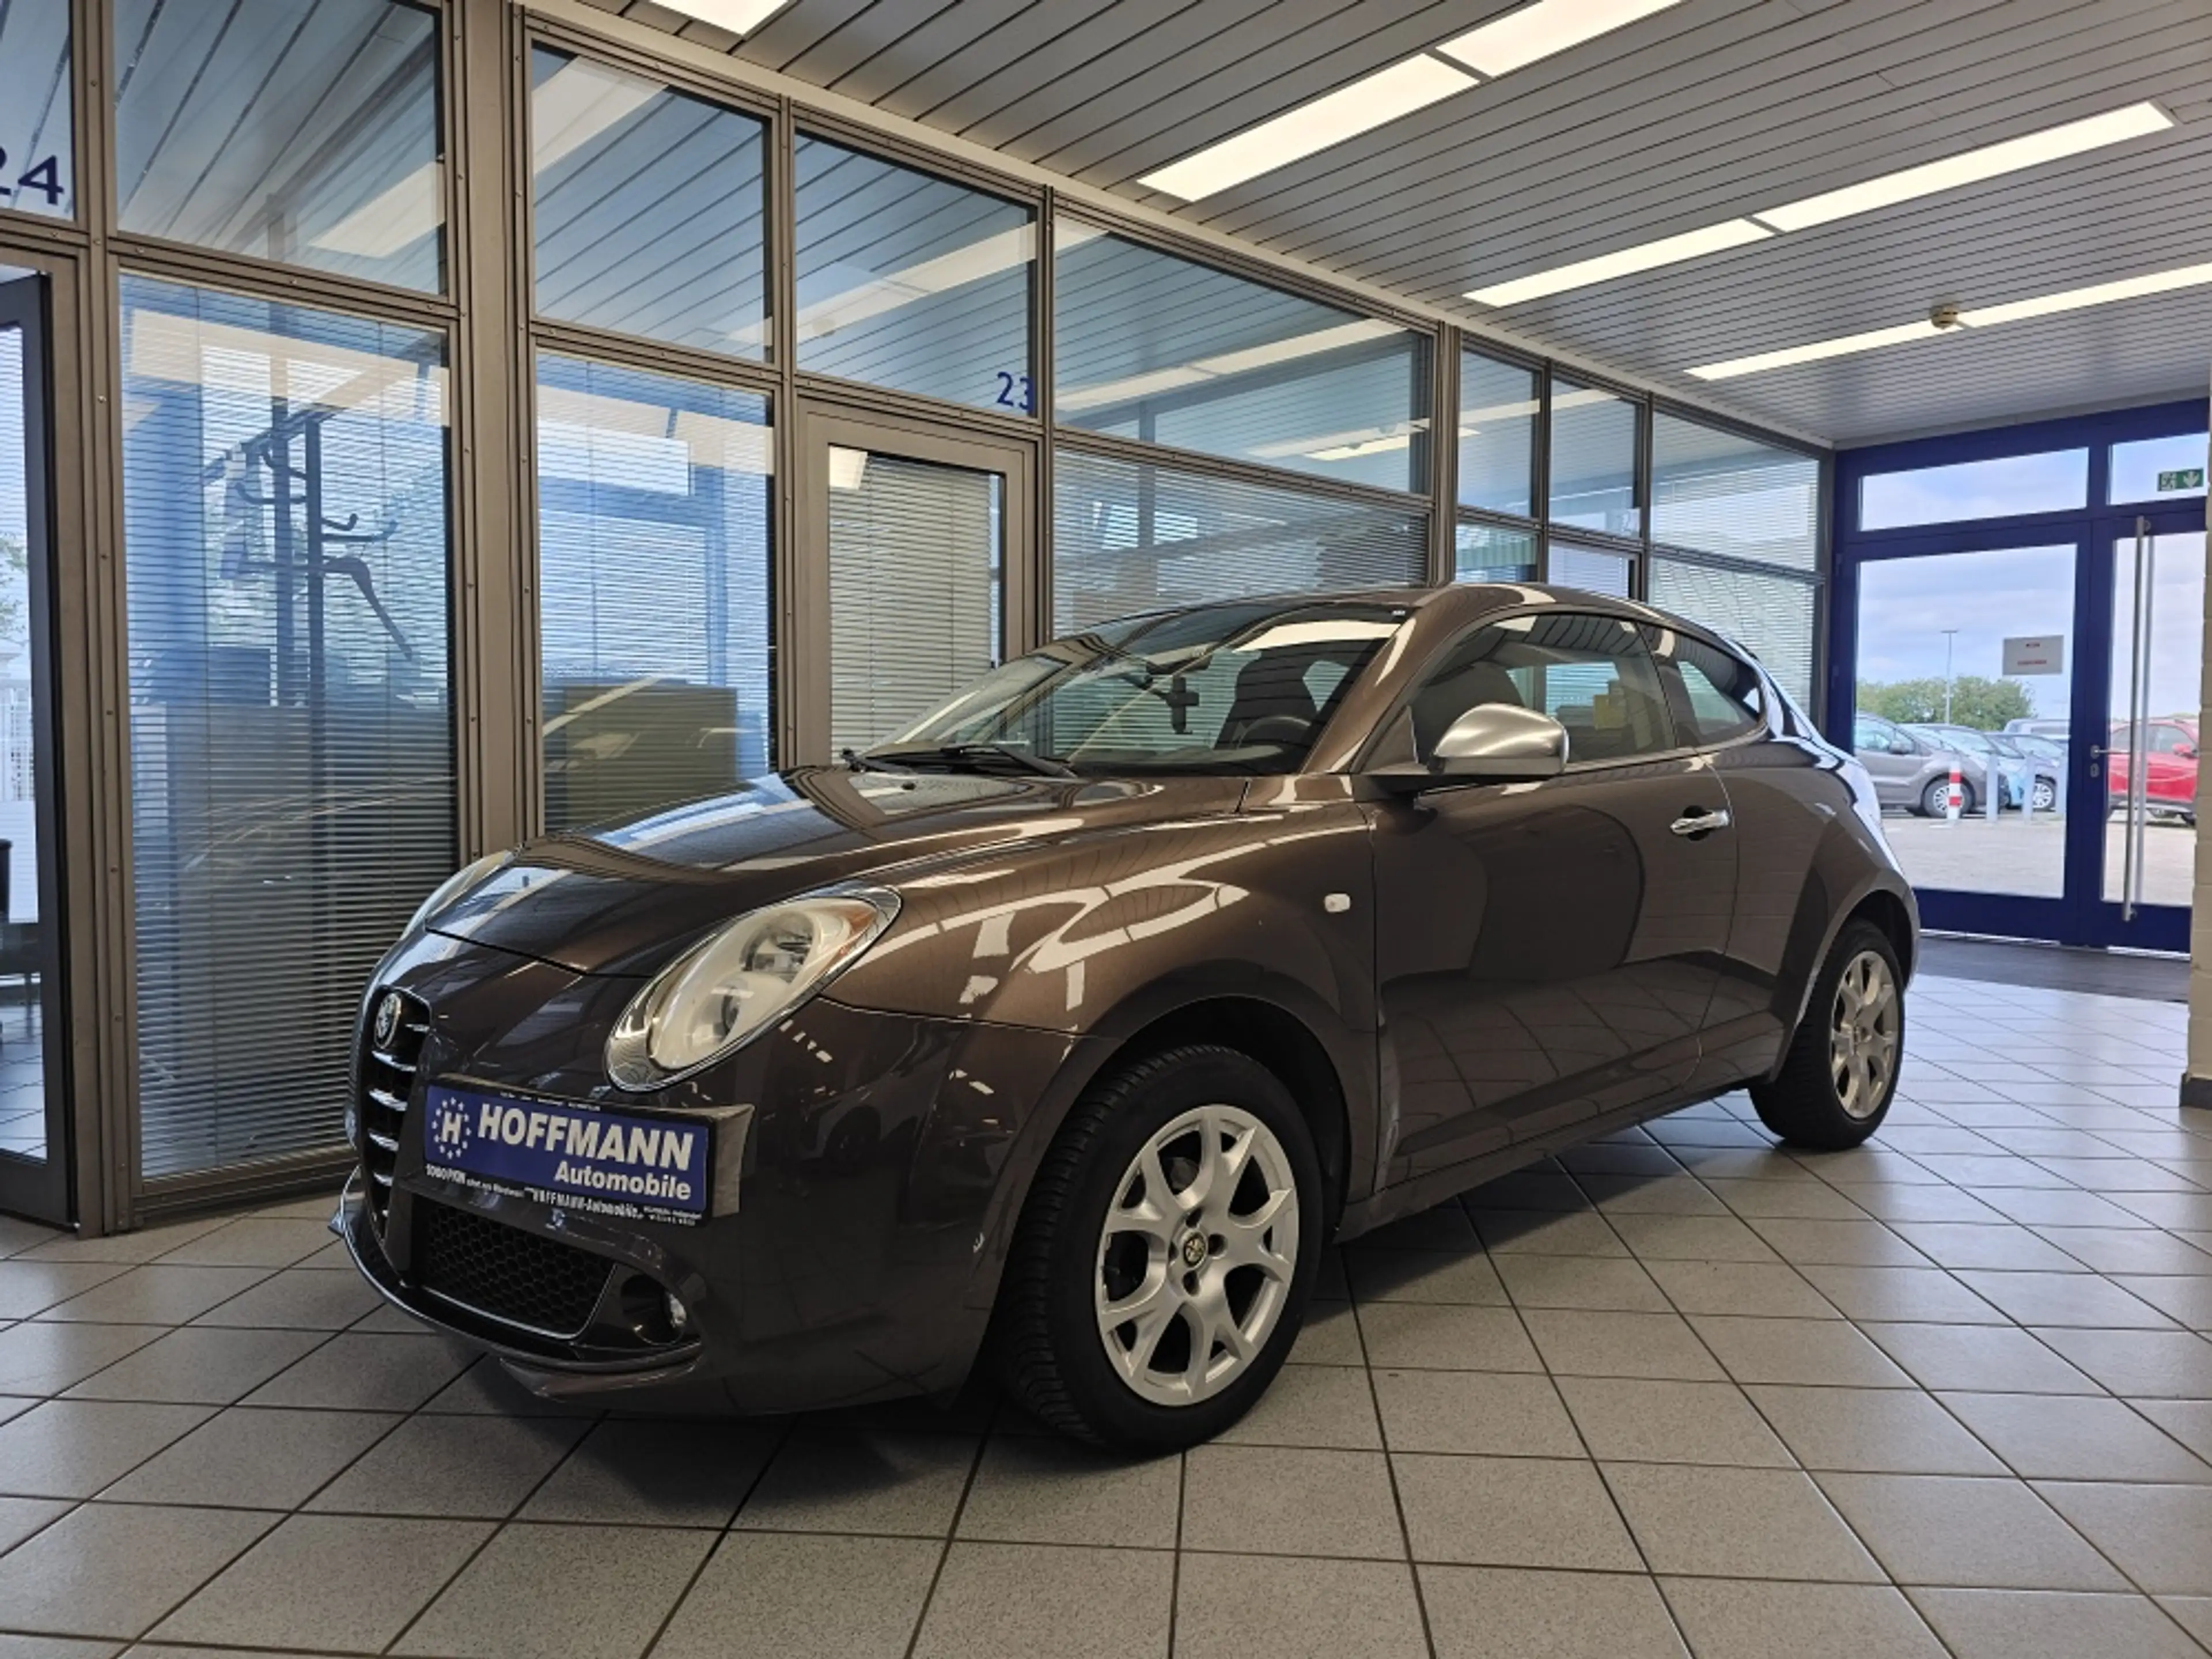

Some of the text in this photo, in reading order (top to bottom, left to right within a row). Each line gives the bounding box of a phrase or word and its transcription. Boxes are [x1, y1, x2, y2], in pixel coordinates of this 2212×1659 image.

[996, 372, 1035, 411] 23
[441, 1110, 463, 1145] H
[478, 1103, 694, 1171] HOFFMANN
[554, 1160, 691, 1200] Automobile
